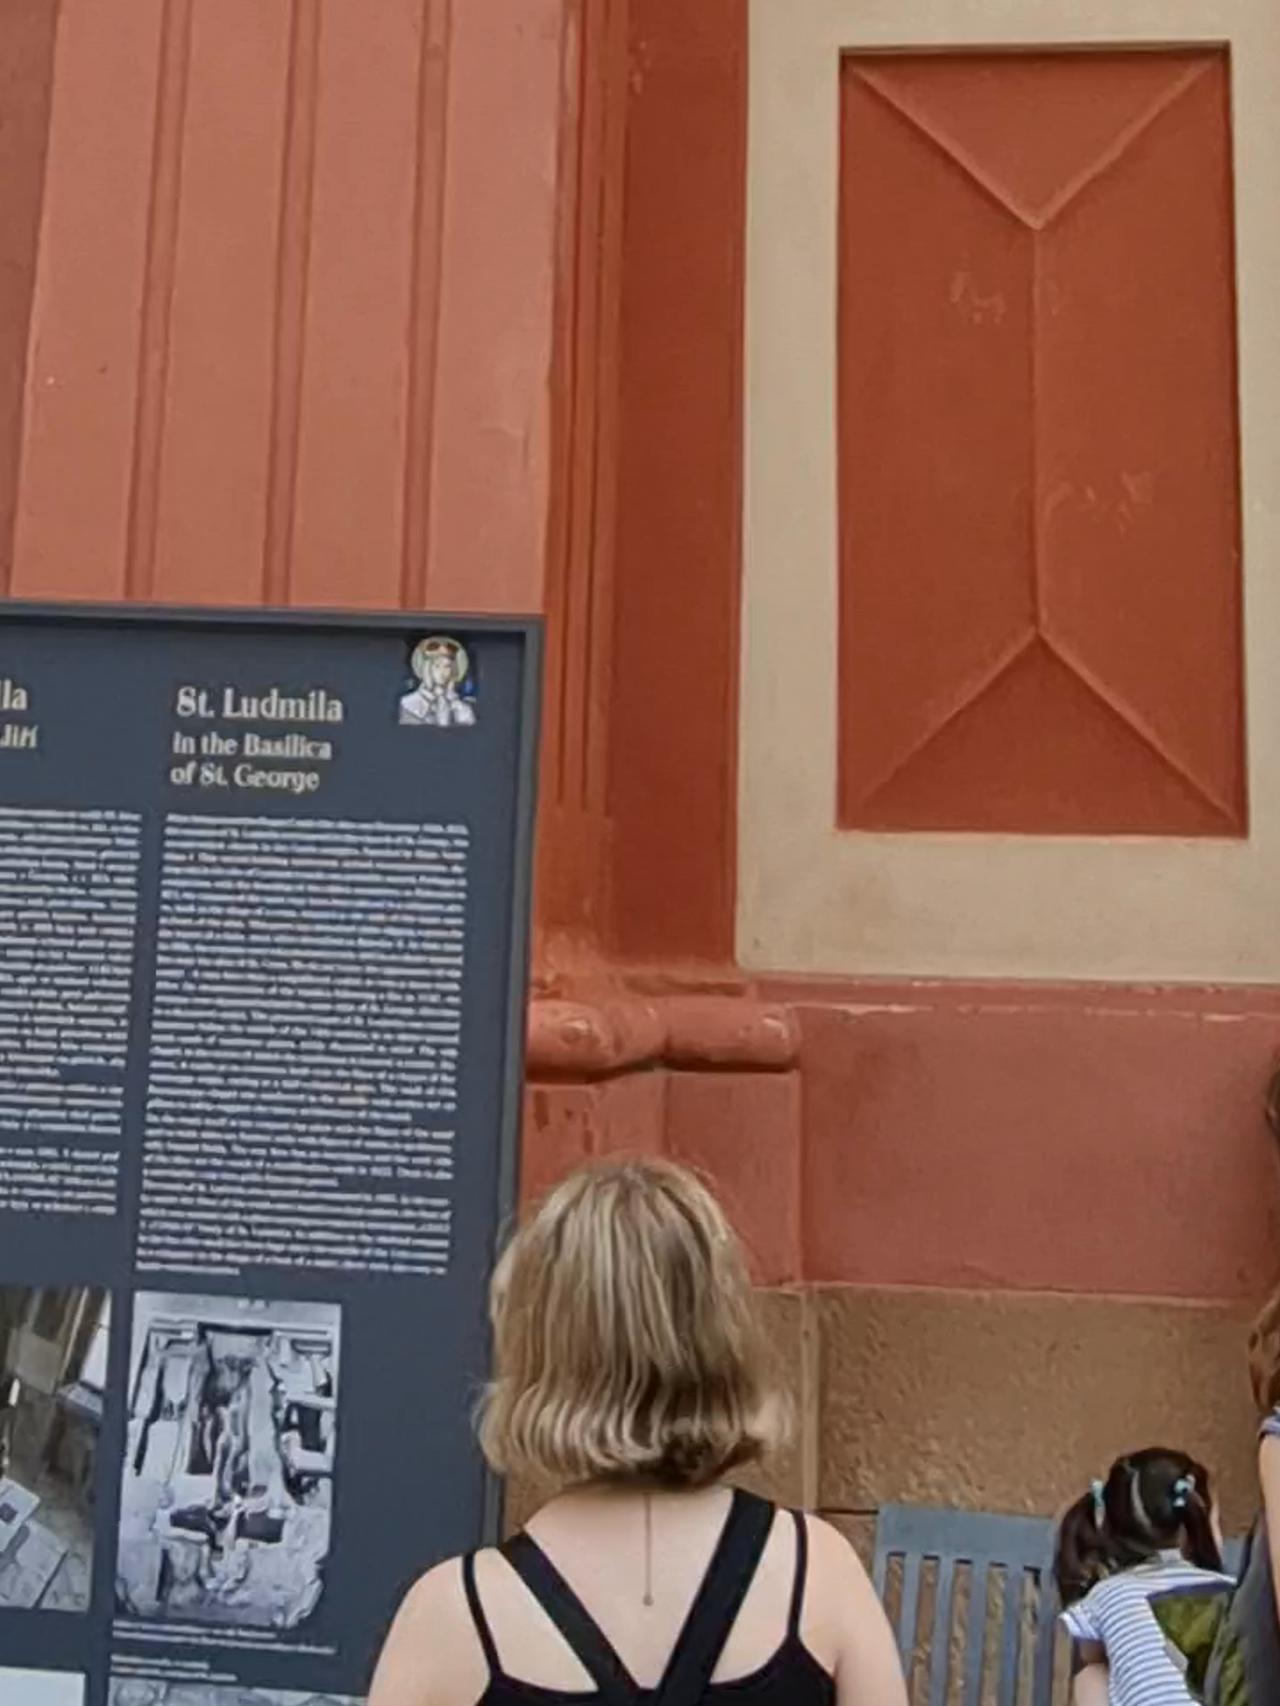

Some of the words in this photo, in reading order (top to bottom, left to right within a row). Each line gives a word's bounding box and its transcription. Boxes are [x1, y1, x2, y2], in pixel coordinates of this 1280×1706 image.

[176, 686, 216, 718] St.
[222, 688, 343, 722] Ludmila
[172, 731, 196, 754] in
[200, 732, 238, 756] the
[243, 733, 333, 760] Basilica
[170, 760, 197, 786] of
[199, 762, 229, 787] St.
[233, 763, 320, 795] George
